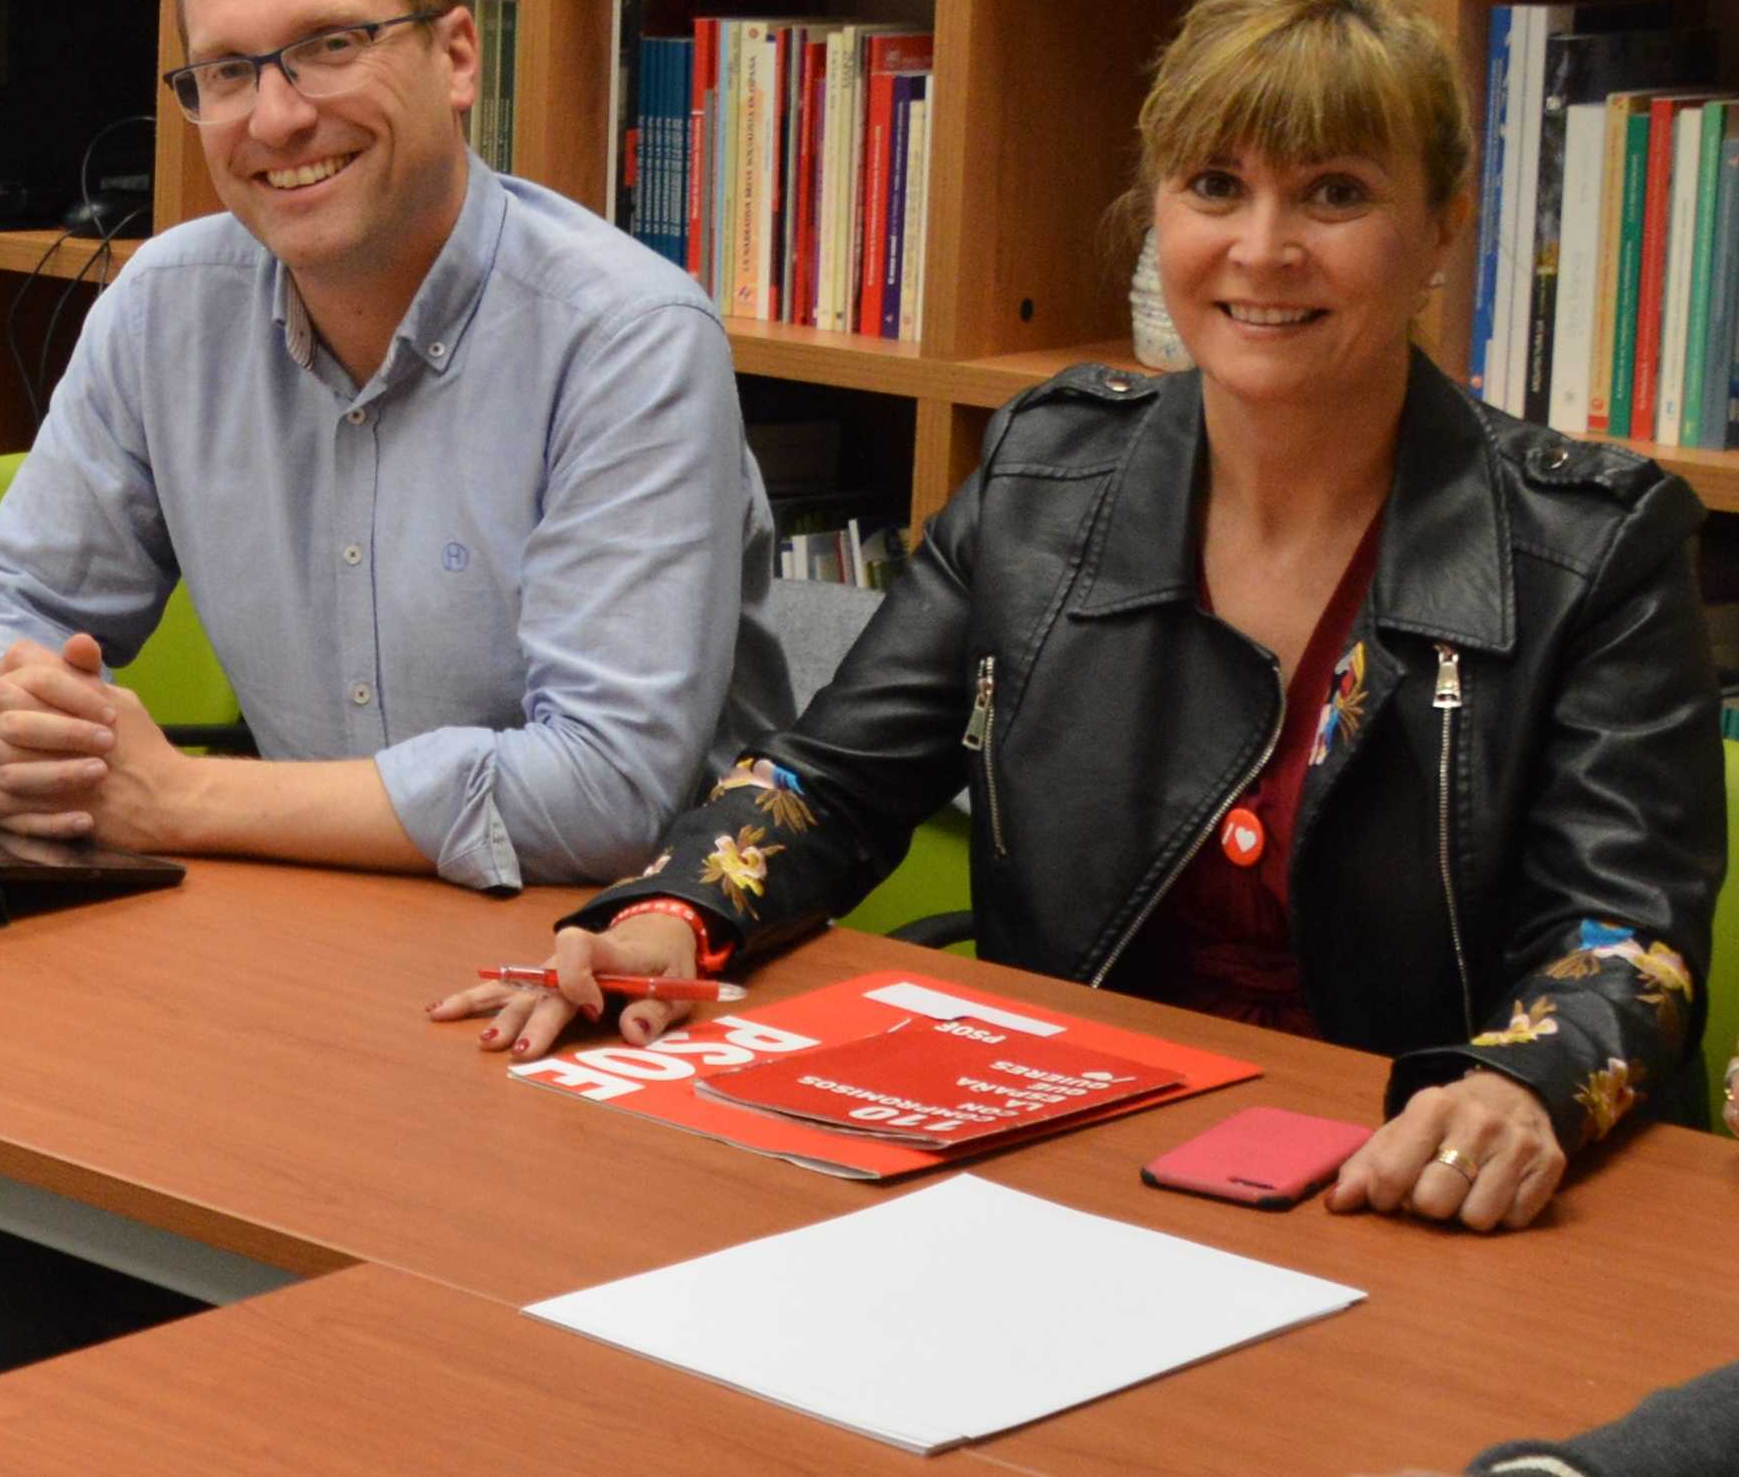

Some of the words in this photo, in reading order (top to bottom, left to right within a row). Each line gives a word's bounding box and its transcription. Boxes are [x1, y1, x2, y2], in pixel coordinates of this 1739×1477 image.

[508, 1015, 822, 1102] PSOE
[989, 1061, 1110, 1090] QUIERES
[797, 1075, 996, 1123] COMPROMISOS
[956, 1076, 1067, 1104] ESPAÑA
[1027, 1082, 1088, 1097] QUE
[957, 1102, 1019, 1118] CON
[1004, 1098, 1044, 1112] LA
[848, 1106, 964, 1132] 110
